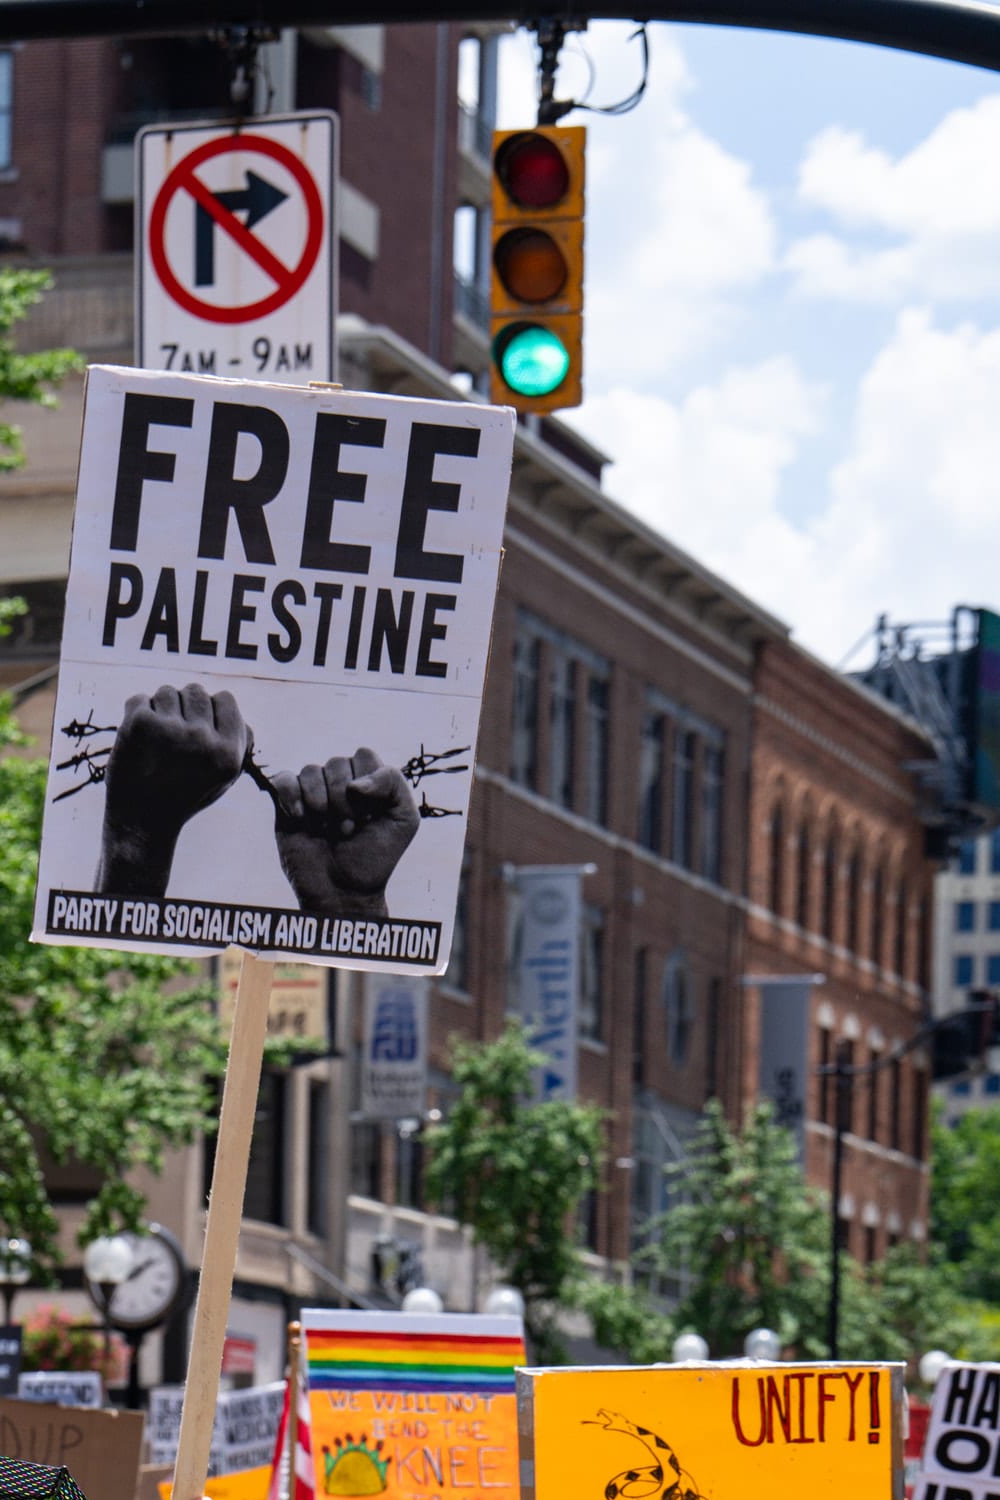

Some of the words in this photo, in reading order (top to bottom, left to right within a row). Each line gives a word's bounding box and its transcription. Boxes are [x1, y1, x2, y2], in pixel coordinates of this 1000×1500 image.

[253, 337, 312, 372] 9AM
[110, 392, 481, 583] FREE
[101, 561, 456, 678] PALESTINE
[52, 895, 117, 933] PARTY
[120, 900, 158, 937] FOR
[163, 905, 272, 947] SOCIALISM
[275, 916, 317, 949] AND
[321, 918, 437, 960] LIBERATION
[328, 1391, 361, 1412] WE
[372, 1391, 438, 1413] WILL
[445, 1391, 495, 1413] NOT
[731, 1372, 880, 1447] UNIFY!
[371, 1419, 428, 1441] BEND
[442, 1419, 489, 1440] THE
[935, 1430, 1000, 1476] O
[395, 1445, 513, 1489] KNEE
